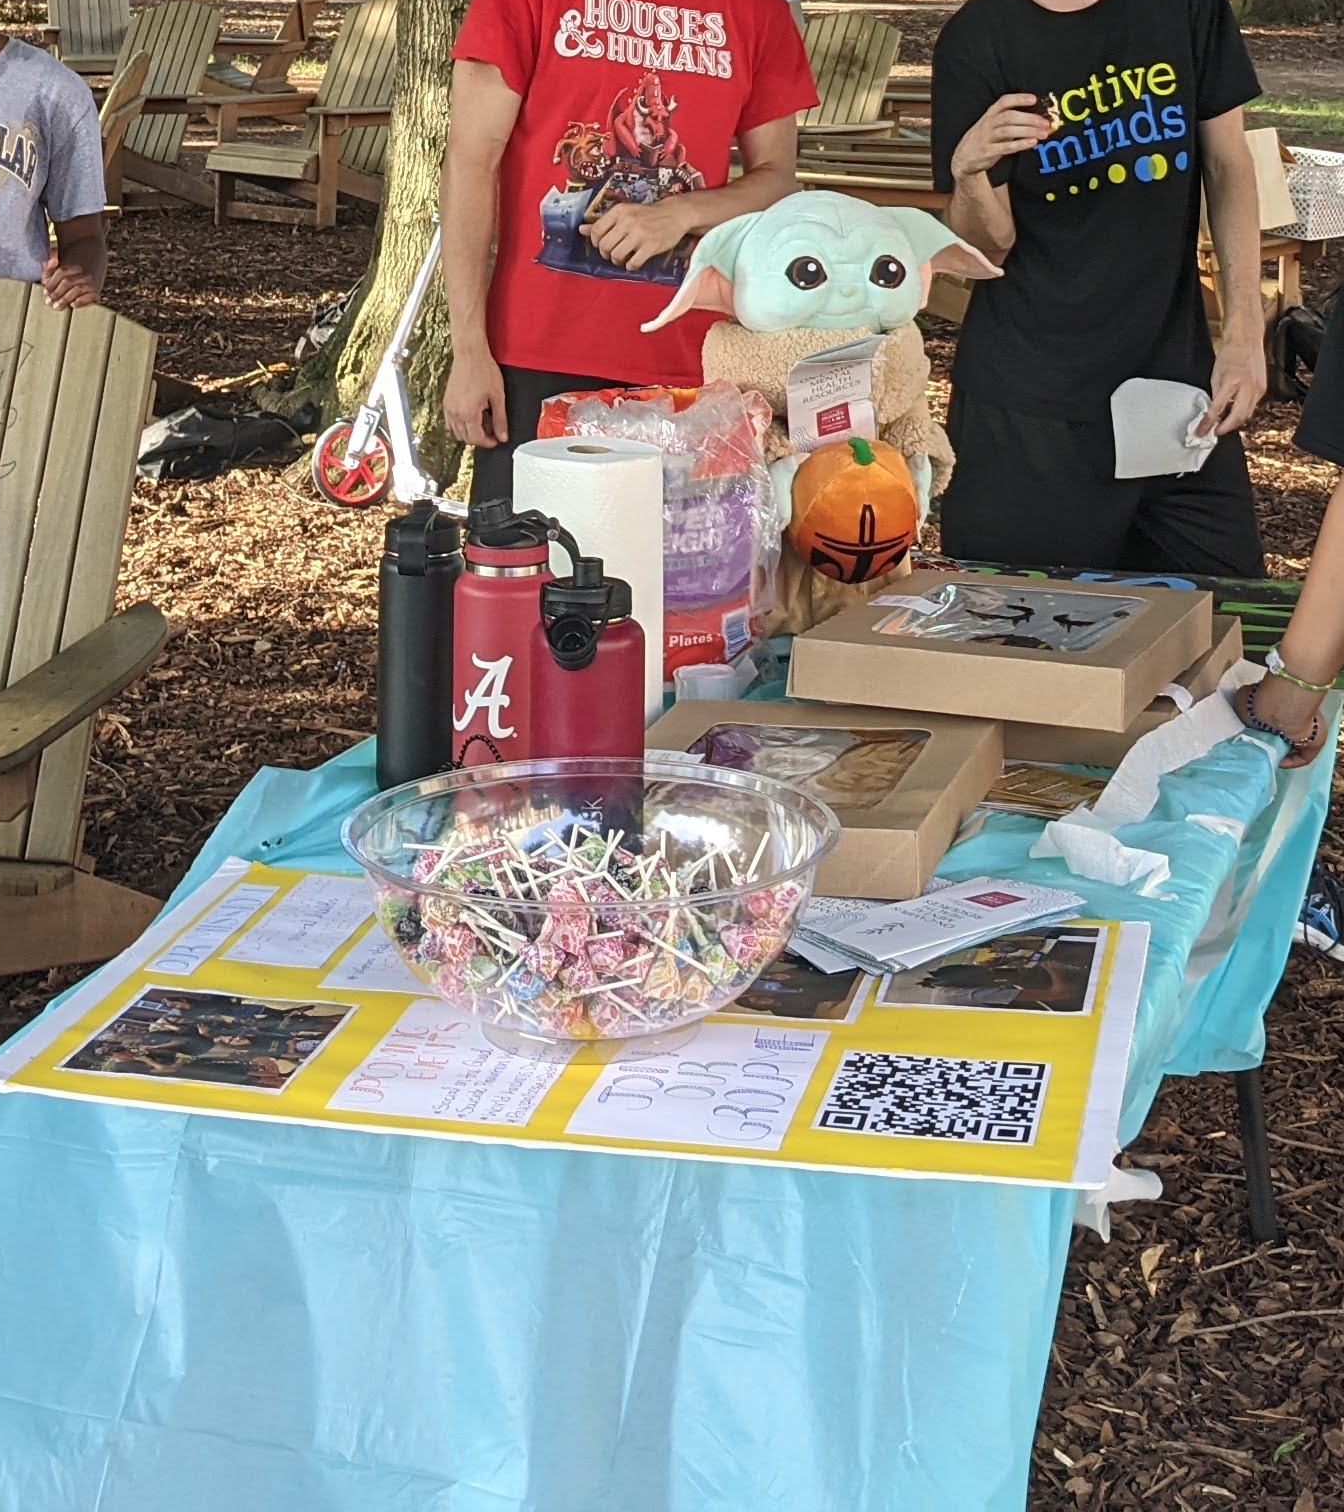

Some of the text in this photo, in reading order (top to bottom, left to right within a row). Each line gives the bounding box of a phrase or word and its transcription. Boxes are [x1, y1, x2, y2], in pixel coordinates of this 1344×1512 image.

[554, 9, 733, 79] & HUMANS
[1056, 62, 1177, 126] ctive
[1033, 94, 1188, 174] minds
[802, 379, 861, 404] RESOURCES
[809, 369, 853, 387] MENTAL
[811, 375, 853, 394] HEALTH
[668, 633, 713, 648] Plates
[452, 652, 515, 739] A
[344, 1026, 429, 1104] UPCOMING
[405, 1021, 471, 1080] EVENTS
[598, 1050, 680, 1111] JOIN
[663, 1061, 738, 1100] OUR
